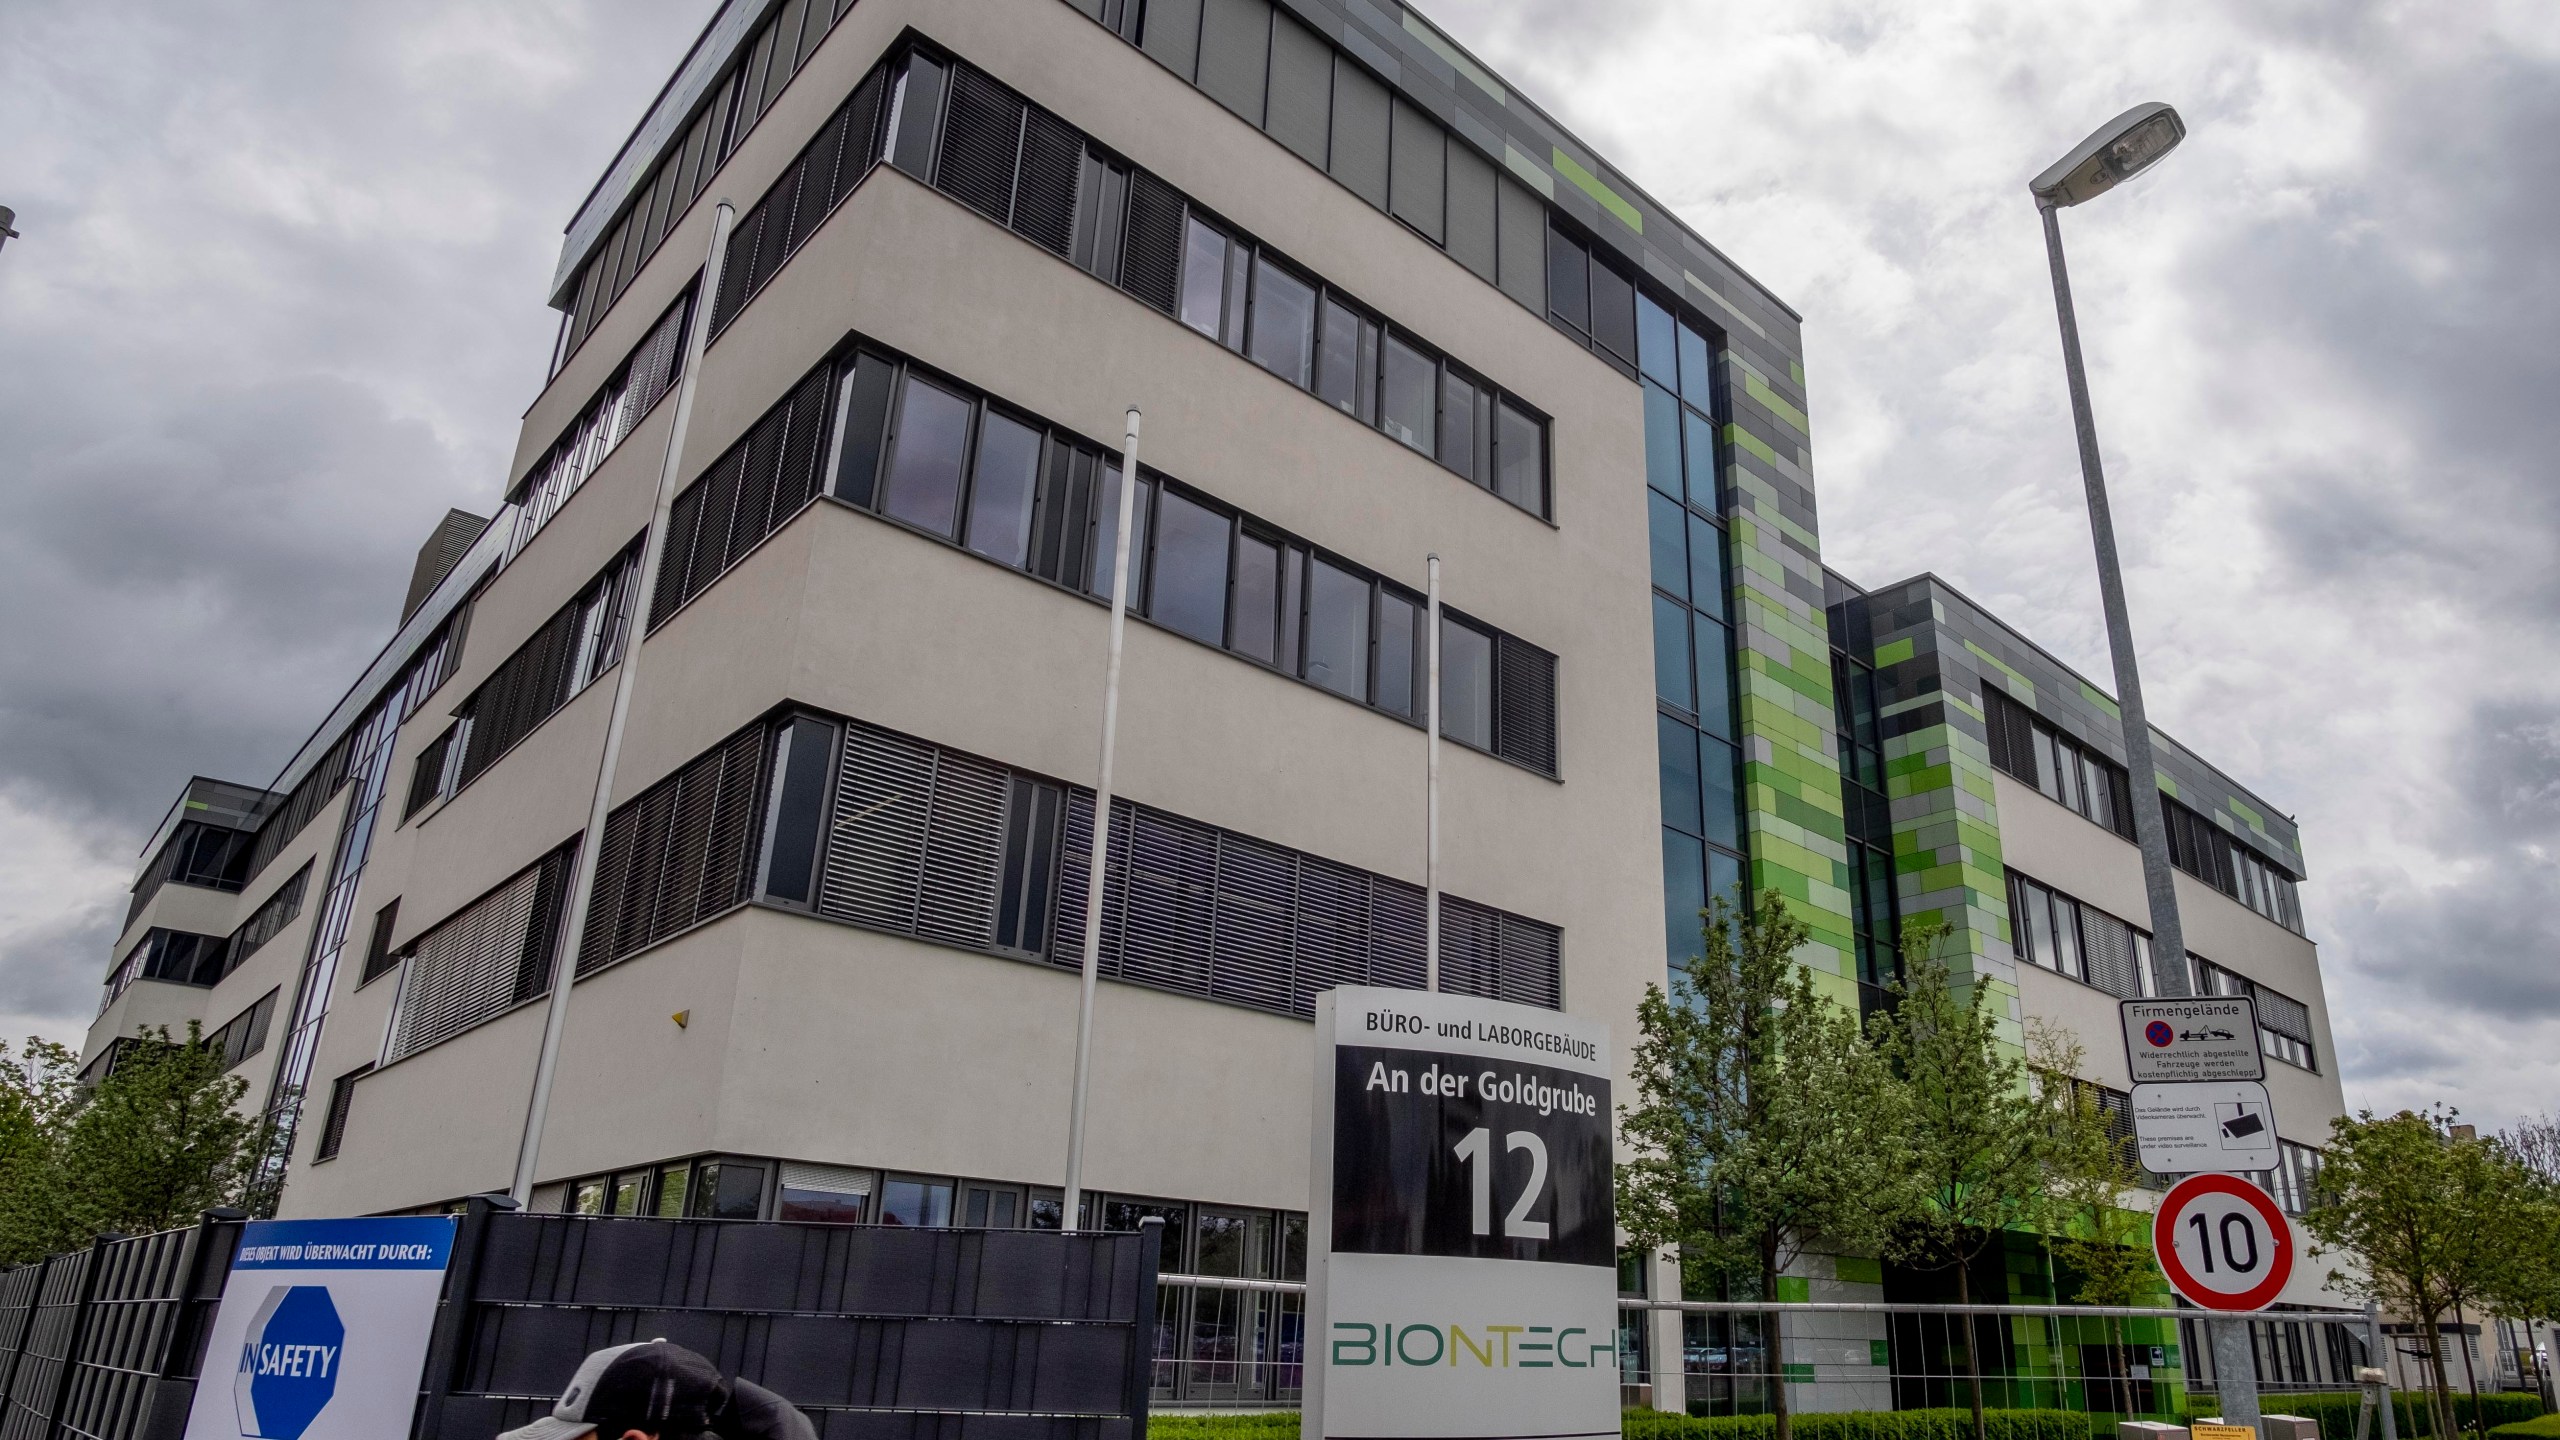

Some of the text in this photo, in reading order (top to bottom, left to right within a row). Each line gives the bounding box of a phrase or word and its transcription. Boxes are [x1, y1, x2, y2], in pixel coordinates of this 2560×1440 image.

[2132, 1003, 2239, 1019] Firmengelände
[1366, 1011, 1597, 1062] BÜRO- und LABORGEBÄUDE
[2139, 1050, 2249, 1060] Widerrechtlich abgestellte
[2156, 1060, 2235, 1069] Fahrzeuge werden
[1366, 1061, 1597, 1117] An der Goldgrube
[2137, 1068, 2257, 1079] kostenpflichtig abgeschleppt
[1453, 1126, 1550, 1240] 12
[239, 1241, 433, 1263] DIESES OBJEKT WIRD ÜBERWACHT DURCH:
[2188, 1212, 2258, 1273] 10
[1332, 1322, 1617, 1368] BIONTECH
